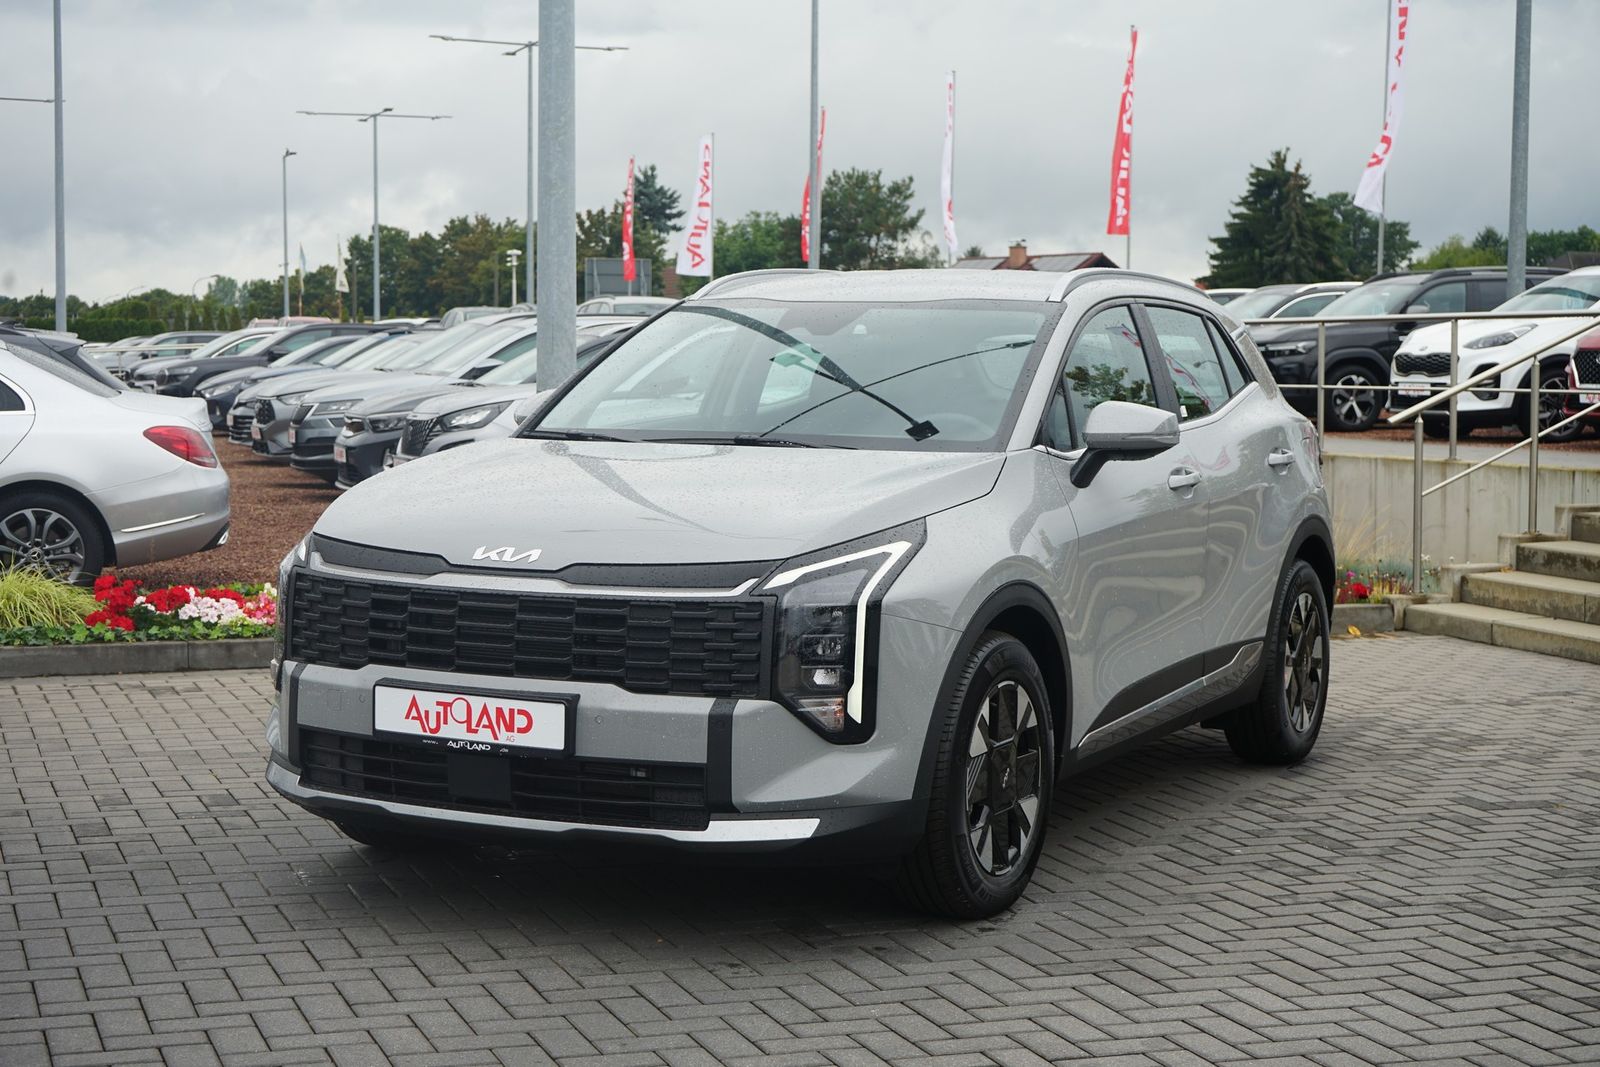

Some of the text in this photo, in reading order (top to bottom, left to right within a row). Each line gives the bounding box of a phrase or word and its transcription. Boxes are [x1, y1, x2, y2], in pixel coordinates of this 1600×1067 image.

[472, 545, 543, 564] KIA
[404, 694, 534, 741] AUTOLAND
[446, 740, 492, 752] AUTOLAND
[505, 735, 516, 744] AG
